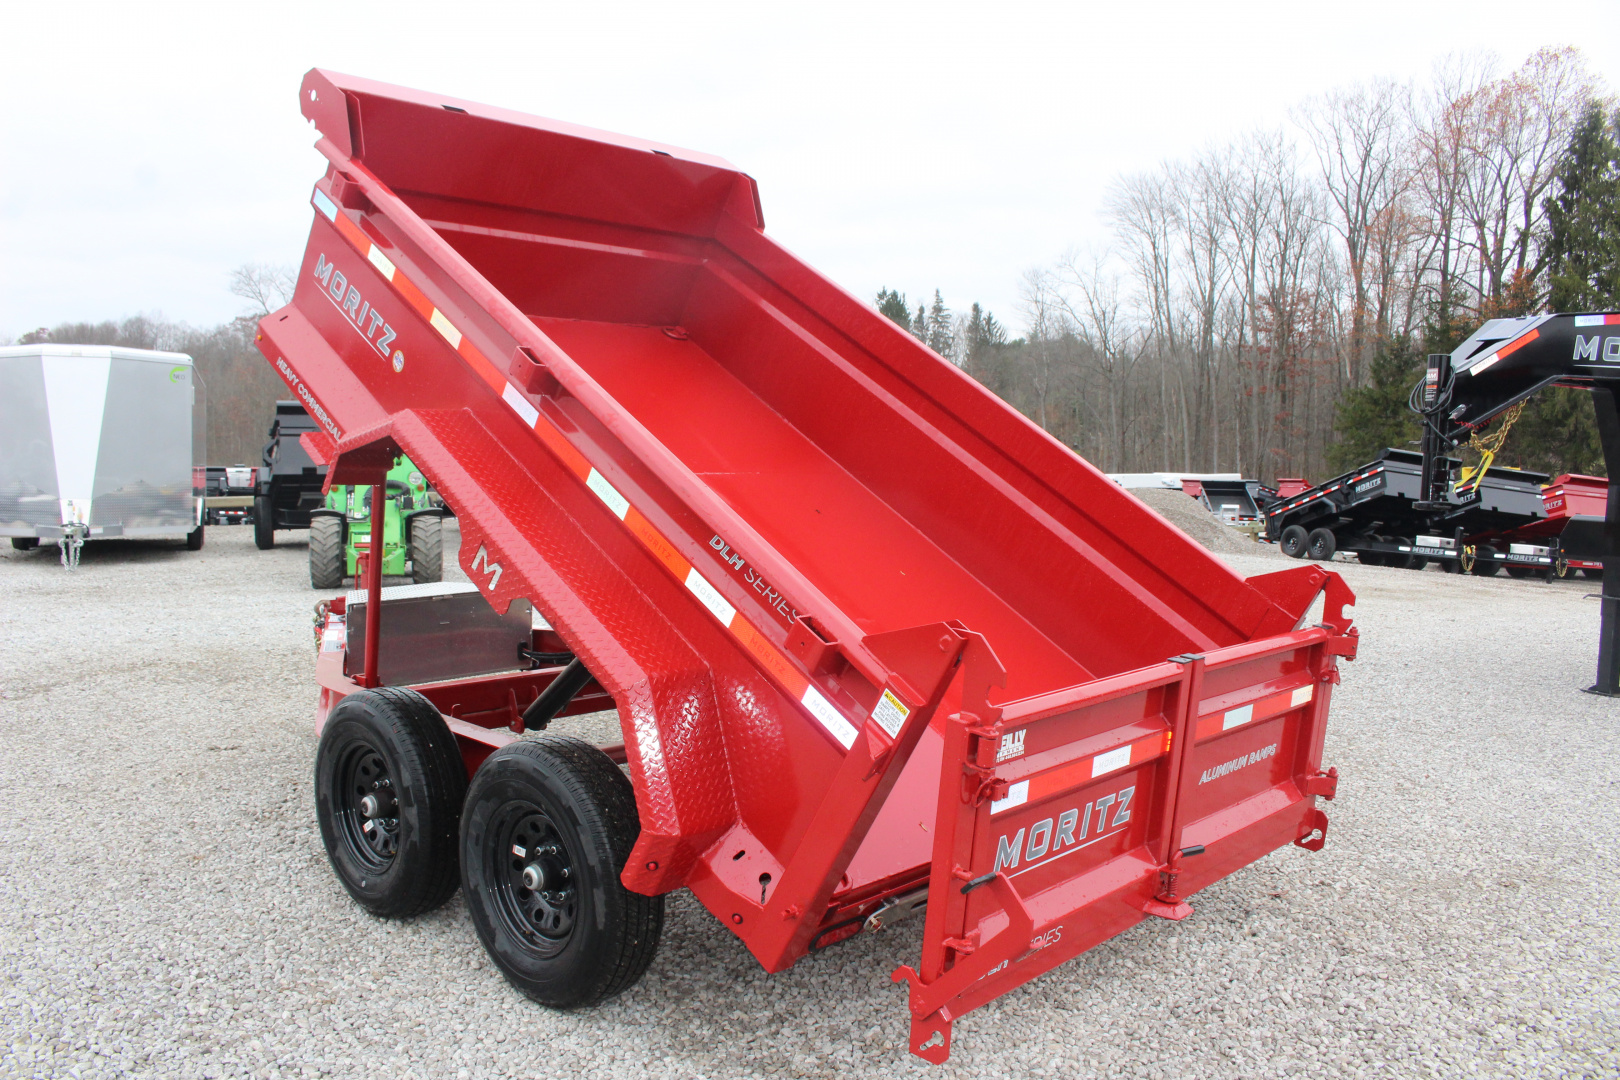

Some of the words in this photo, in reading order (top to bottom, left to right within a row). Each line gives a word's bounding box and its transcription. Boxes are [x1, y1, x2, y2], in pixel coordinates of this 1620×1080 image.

[314, 253, 397, 357] MORITZ
[276, 356, 299, 386] HEAVY
[298, 383, 342, 442] COMMERCIAL
[1355, 477, 1382, 493] MORITZ
[1412, 546, 1445, 555] MORITZ
[1506, 553, 1539, 562] MORITZ
[693, 580, 728, 616] MORITZ
[709, 534, 746, 571] DLH
[743, 567, 797, 625] SERIES
[811, 700, 850, 738] MORITZ
[888, 695, 907, 715] CAUTION
[1198, 755, 1248, 785] ALUMINUM
[1248, 743, 1277, 765] RAMPS
[993, 785, 1136, 872] MORITZ
